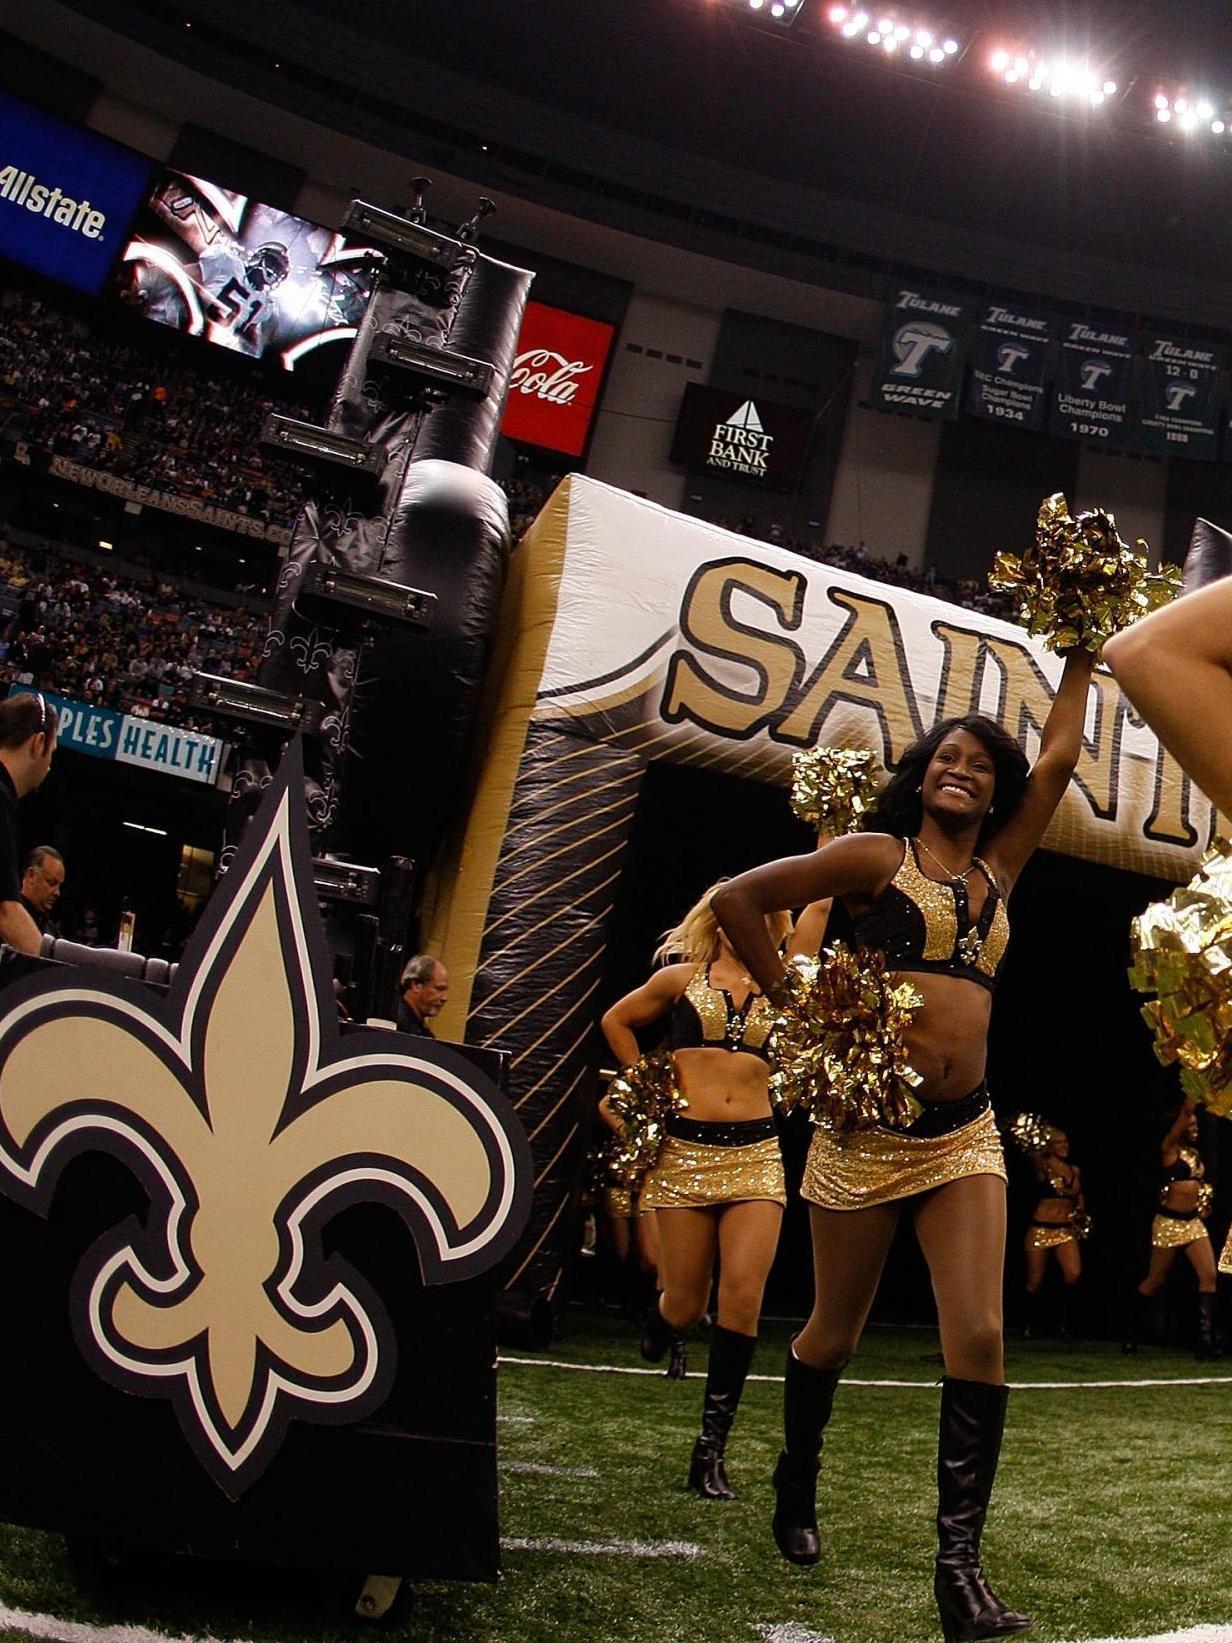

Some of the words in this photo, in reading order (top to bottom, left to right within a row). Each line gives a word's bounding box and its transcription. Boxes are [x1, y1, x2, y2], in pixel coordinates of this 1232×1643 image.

[0, 165, 105, 239] Allstate
[207, 277, 263, 335] 51
[896, 290, 961, 317] TULANE
[986, 306, 1047, 330] TULANE
[1069, 323, 1128, 346] TULANE
[1153, 340, 1214, 361] TULANE
[881, 383, 953, 400] GREEN
[883, 393, 946, 409] WAVE
[986, 404, 1024, 421] 1934
[1057, 393, 1096, 409] Liberty
[1099, 400, 1127, 413] Bowl
[1059, 403, 1122, 422] Champions
[713, 424, 774, 451] FIRST
[1070, 422, 1109, 437] 1970
[709, 440, 770, 468] BANK
[706, 457, 731, 469] AND
[732, 461, 767, 477] TRUST
[55, 705, 114, 749] PLES
[122, 724, 216, 776] HEALTH
